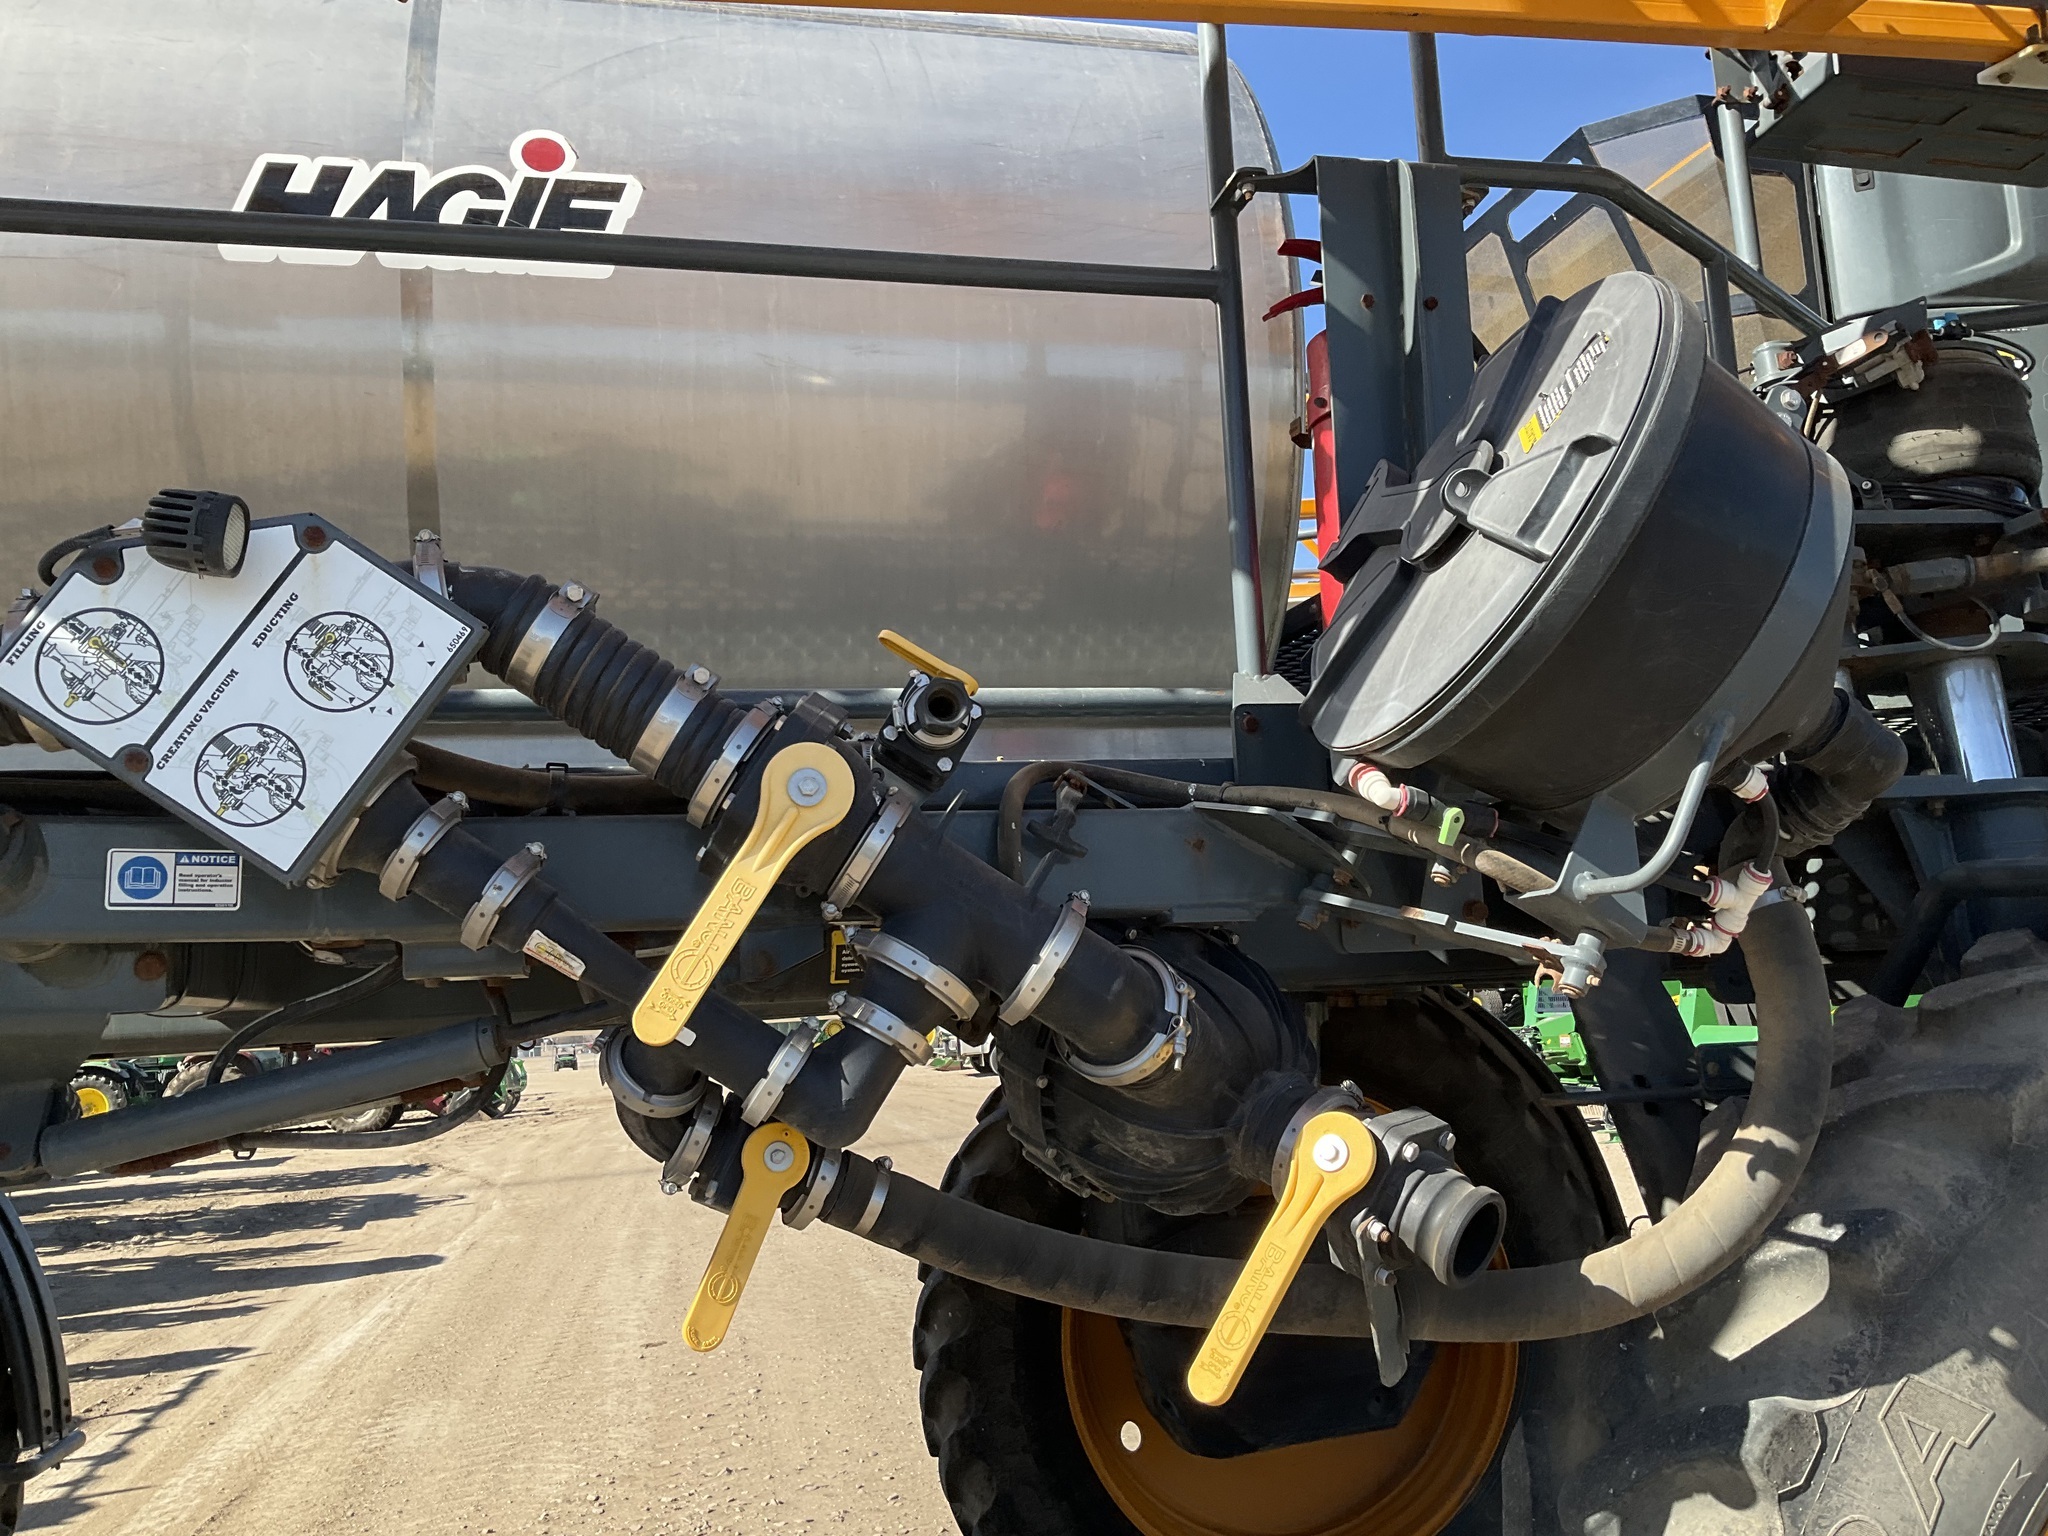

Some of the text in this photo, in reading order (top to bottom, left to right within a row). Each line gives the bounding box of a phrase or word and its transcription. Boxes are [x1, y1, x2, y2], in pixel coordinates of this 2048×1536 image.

[244, 137, 628, 233] HAGIE
[5, 620, 46, 666] FILLING
[251, 592, 299, 648] EDUCTING
[446, 626, 468, 653] 650469
[156, 668, 239, 770] CREATING VACUUM
[191, 854, 236, 864] NOTICE
